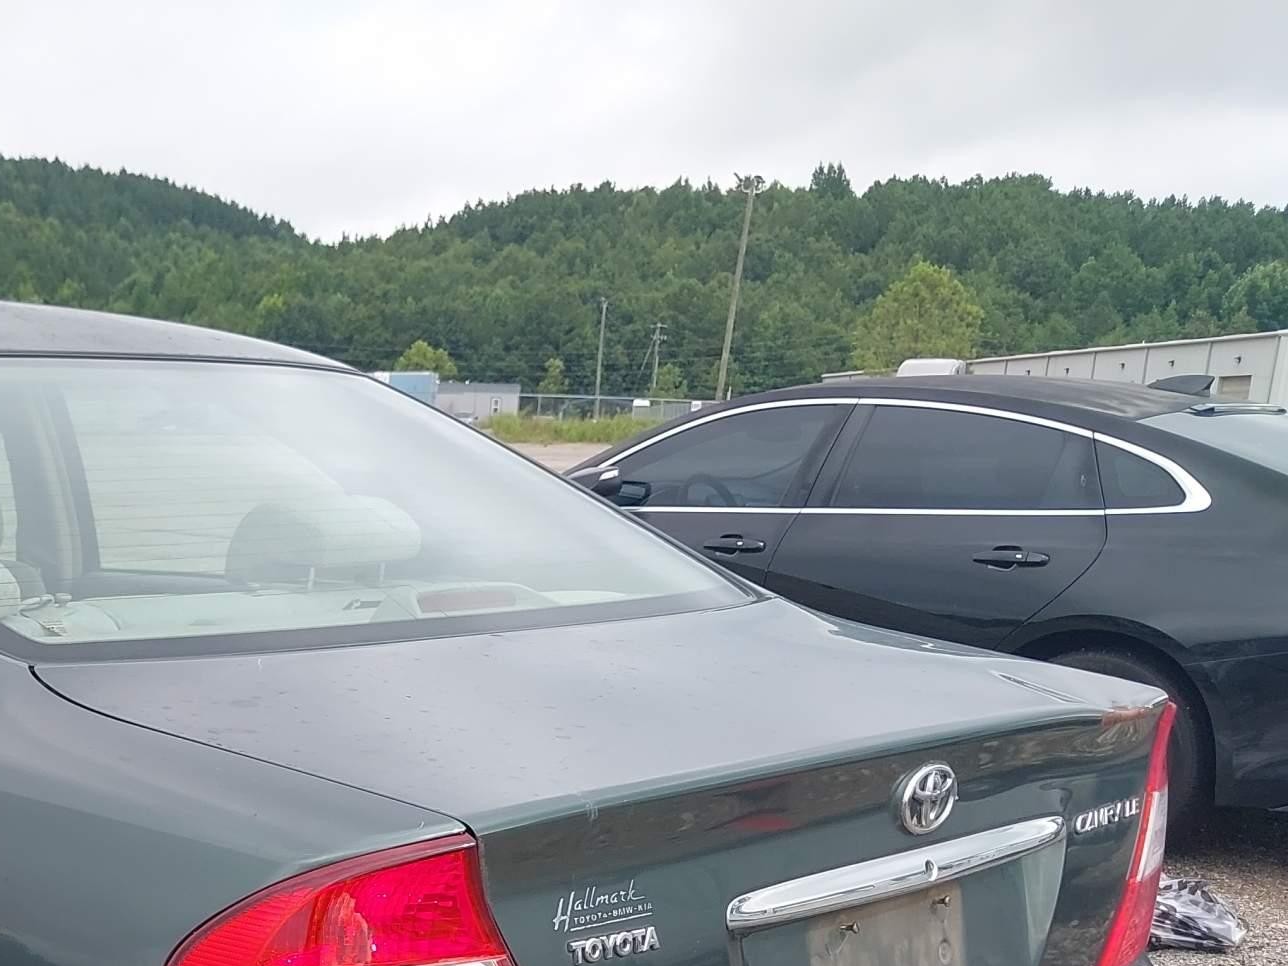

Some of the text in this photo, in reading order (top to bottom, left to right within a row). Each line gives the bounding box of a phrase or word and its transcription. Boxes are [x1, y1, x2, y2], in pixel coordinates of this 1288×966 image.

[1124, 797, 1141, 818] LE
[552, 879, 646, 932] Hallmark
[568, 926, 660, 966] TOYOTA
